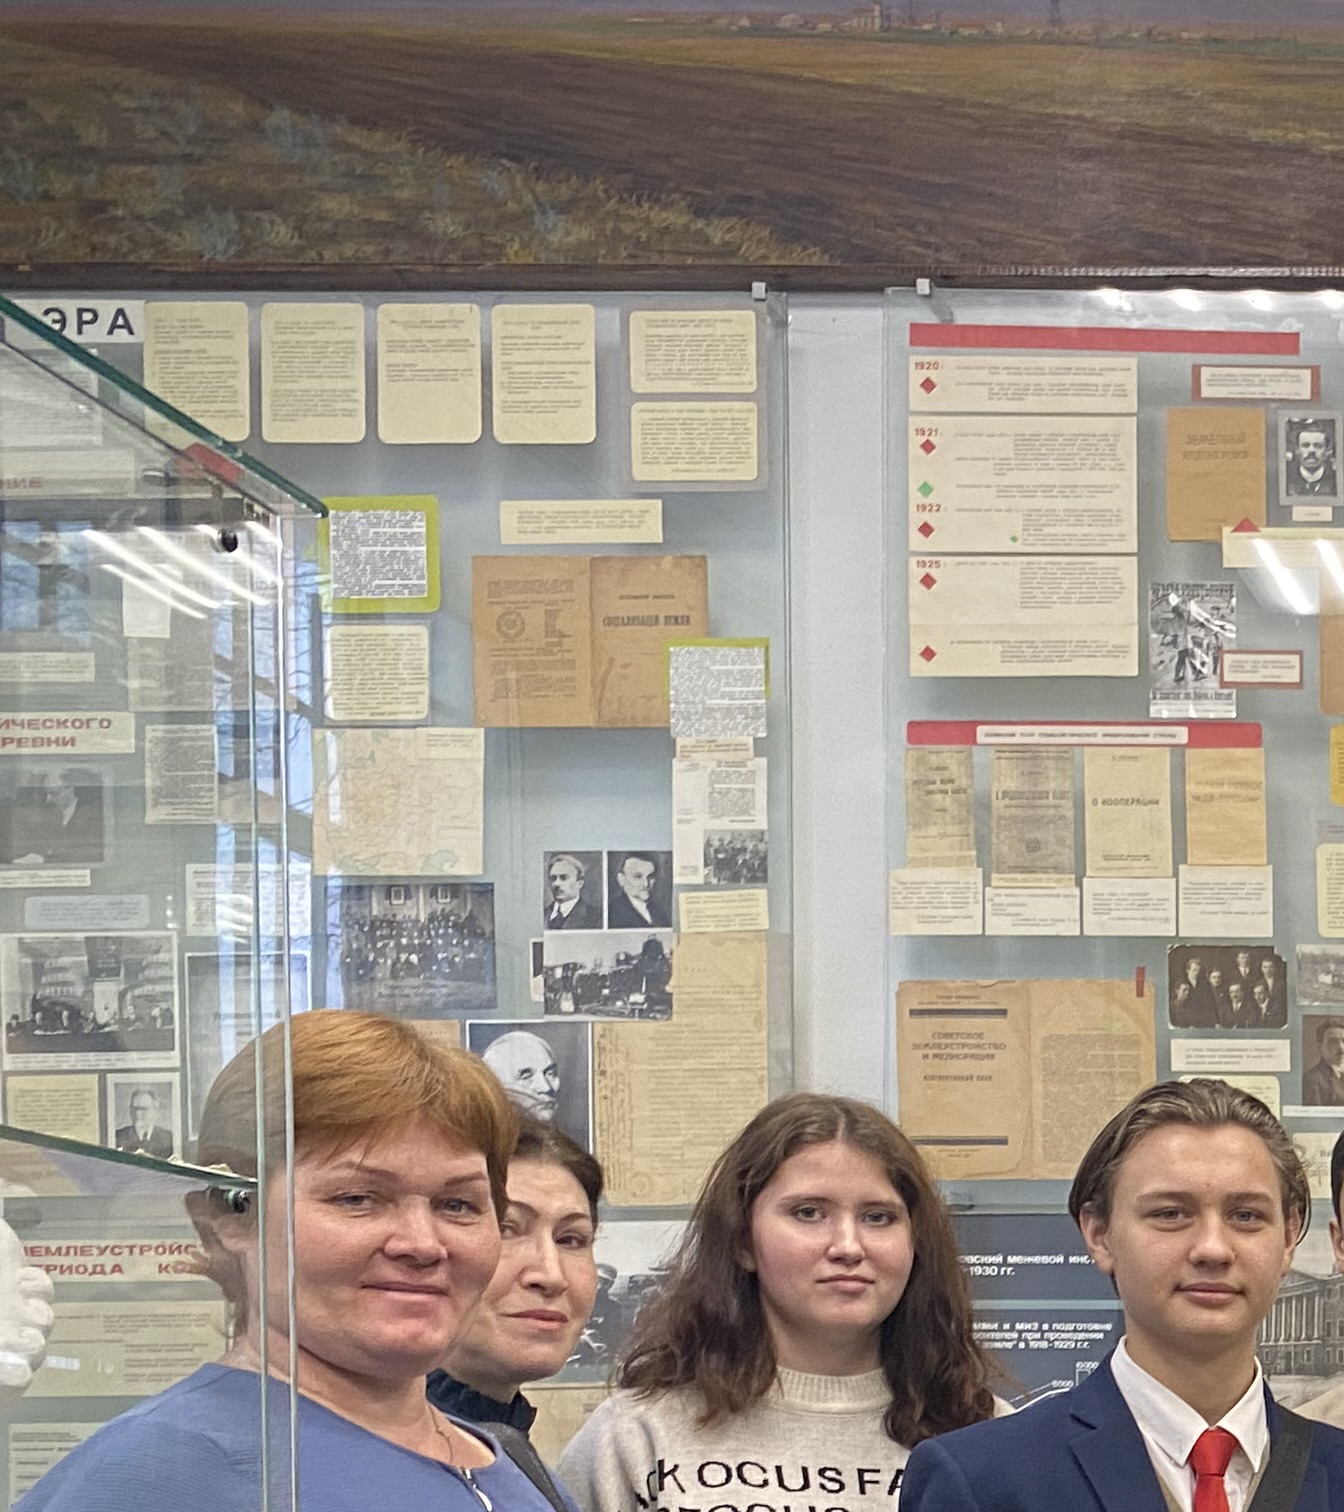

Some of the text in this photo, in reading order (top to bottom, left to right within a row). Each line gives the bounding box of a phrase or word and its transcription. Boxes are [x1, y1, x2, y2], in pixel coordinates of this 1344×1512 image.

[42, 307, 135, 336] ЭРА
[914, 361, 940, 371] 1920
[914, 428, 939, 437] 1921
[916, 503, 942, 513] 1922
[916, 559, 942, 569] 1925
[0, 717, 112, 731] ИЧЕСКОГО
[1, 735, 77, 748] РЕВНИ
[1007, 1254, 1064, 1265] межевой
